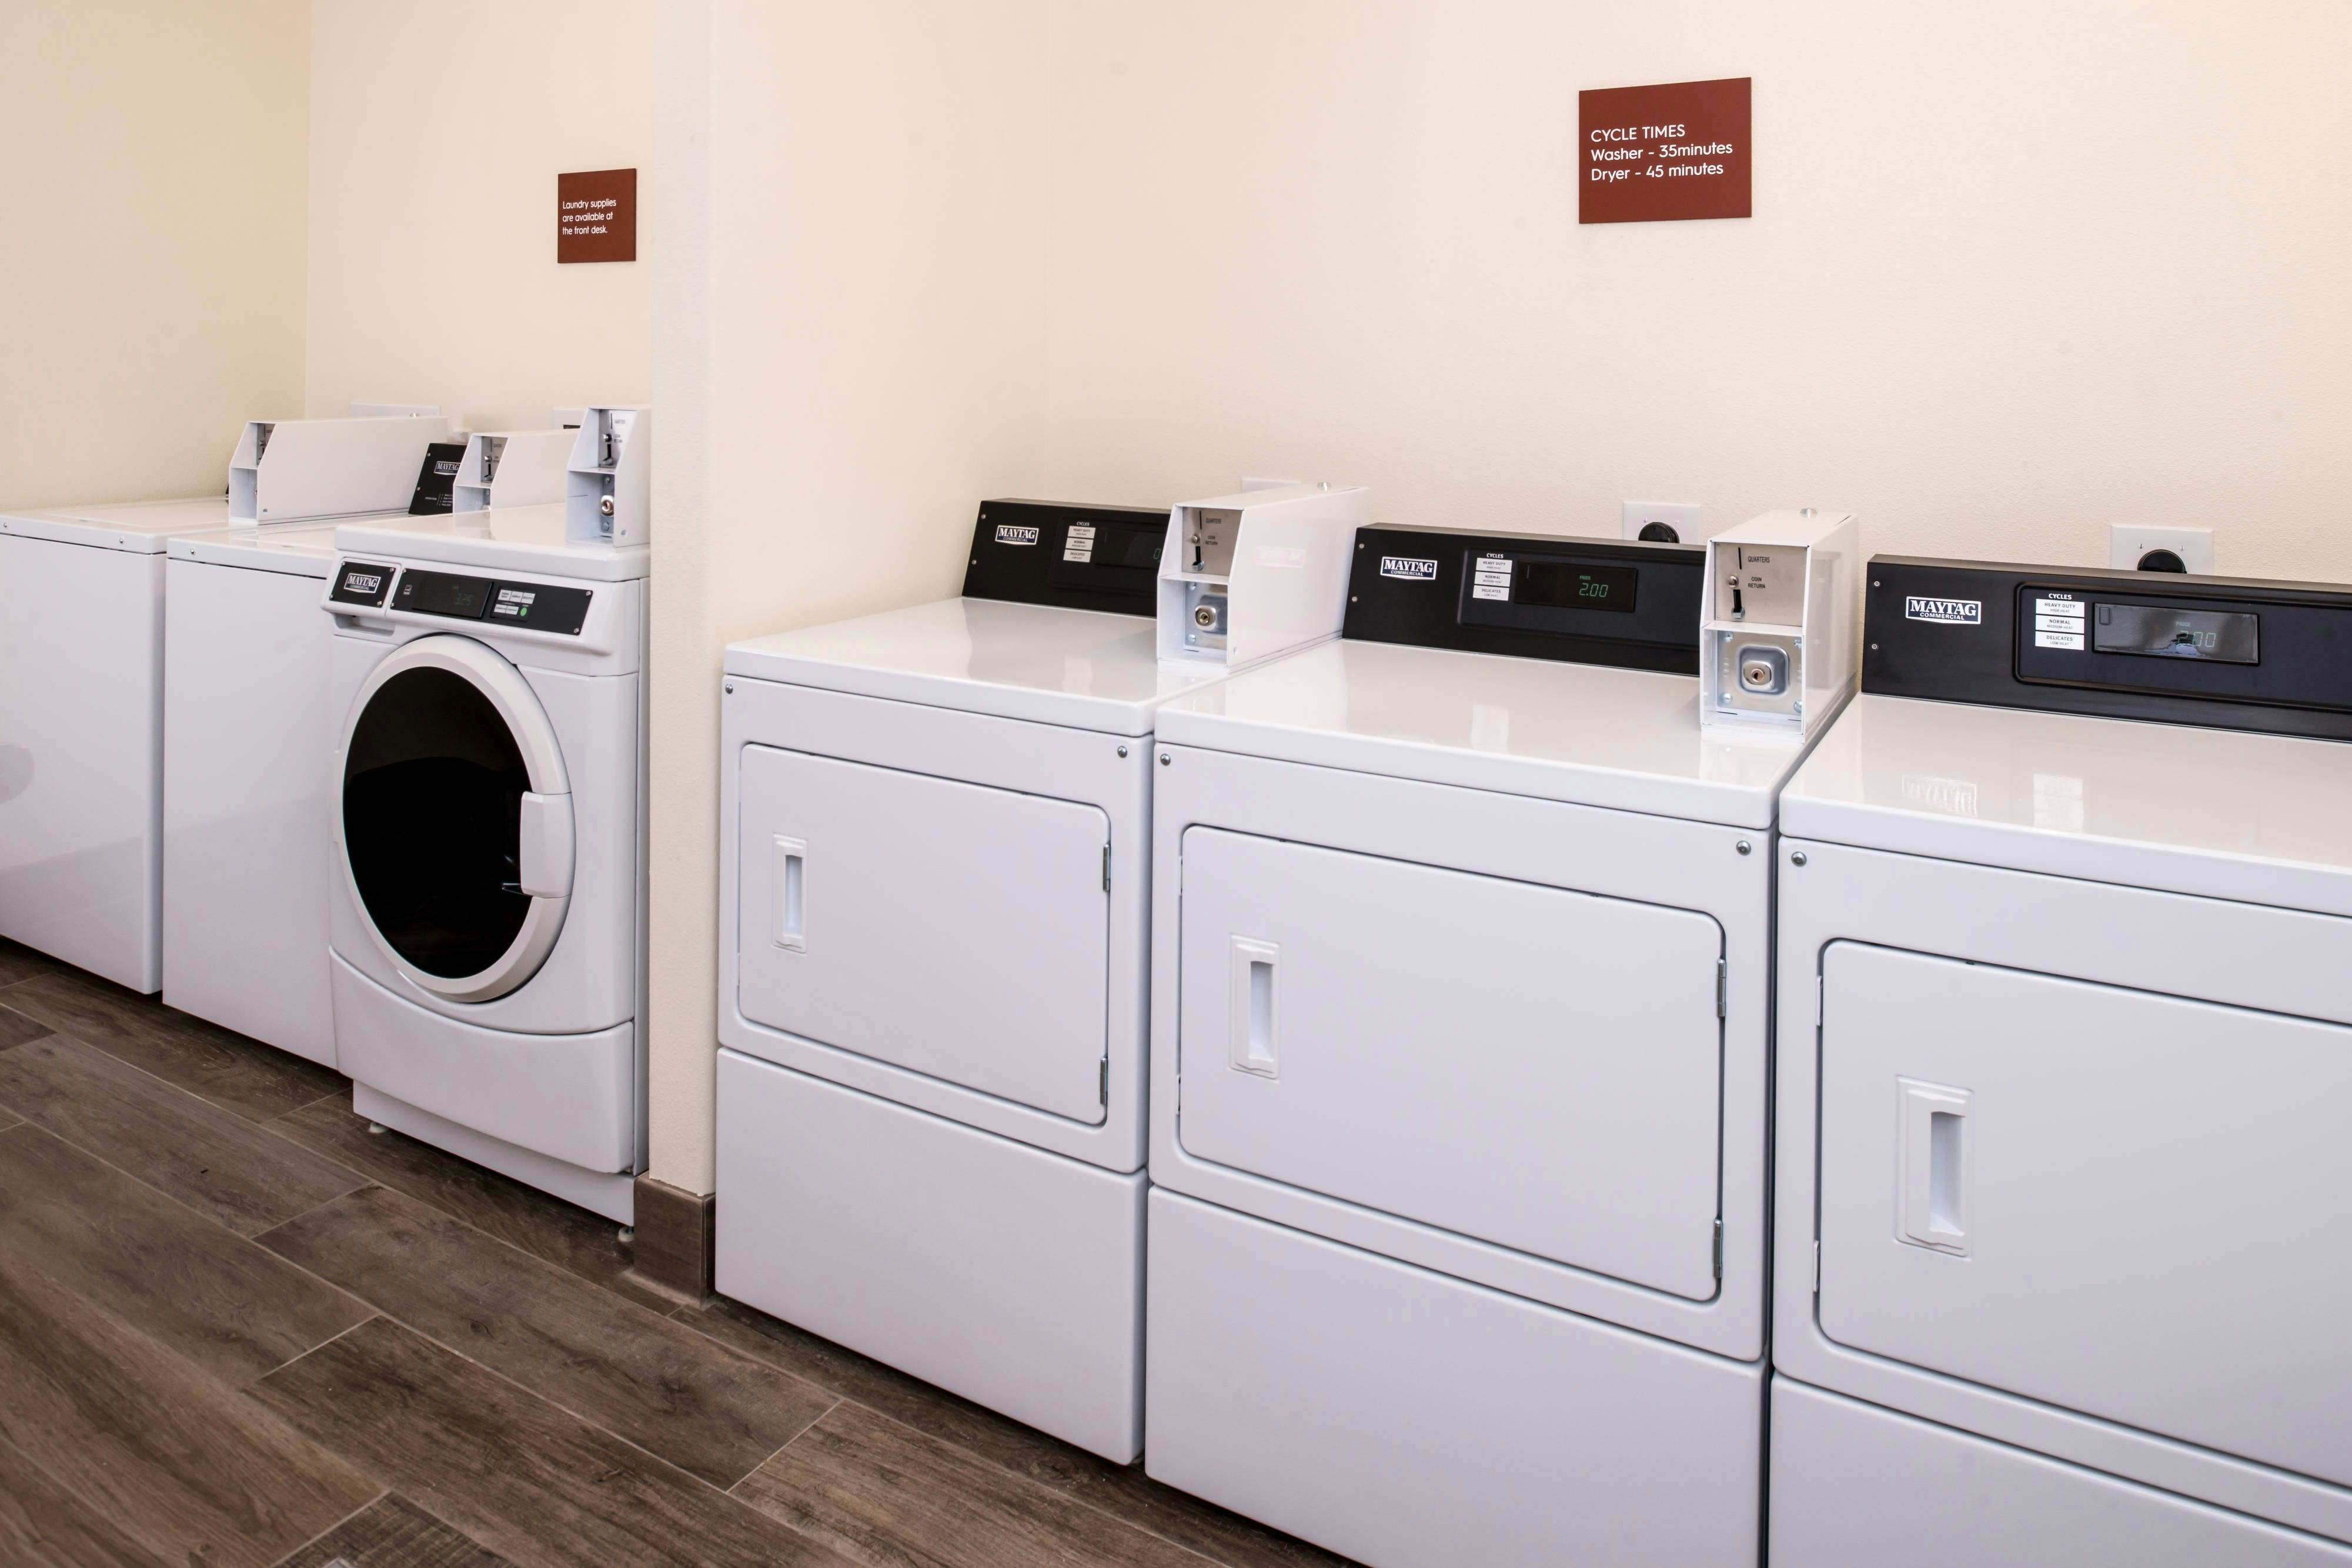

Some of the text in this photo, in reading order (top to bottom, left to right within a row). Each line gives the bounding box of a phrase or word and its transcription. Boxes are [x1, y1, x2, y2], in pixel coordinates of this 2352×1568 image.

[1591, 124, 1685, 142] CYCLE TIMES
[1591, 148, 1643, 162] Washer
[1658, 142, 1733, 158] 35minutes
[1591, 168, 1631, 183] Dryer
[1646, 165, 1664, 178] 45
[1668, 162, 1724, 177] minutes
[563, 198, 617, 210] Laundry supplies
[574, 212, 604, 222] available
[606, 212, 613, 220] at
[562, 225, 608, 235] the front desk.
[436, 463, 459, 471] MAYTAG
[998, 527, 1036, 539] MAYTAG
[1384, 559, 1434, 573] MAYTAG
[348, 575, 377, 587] MAYTAG
[1579, 583, 1609, 598] 2.00
[1909, 600, 1977, 616] MAYTAG
[1919, 612, 1965, 620] COMMERCIAL
